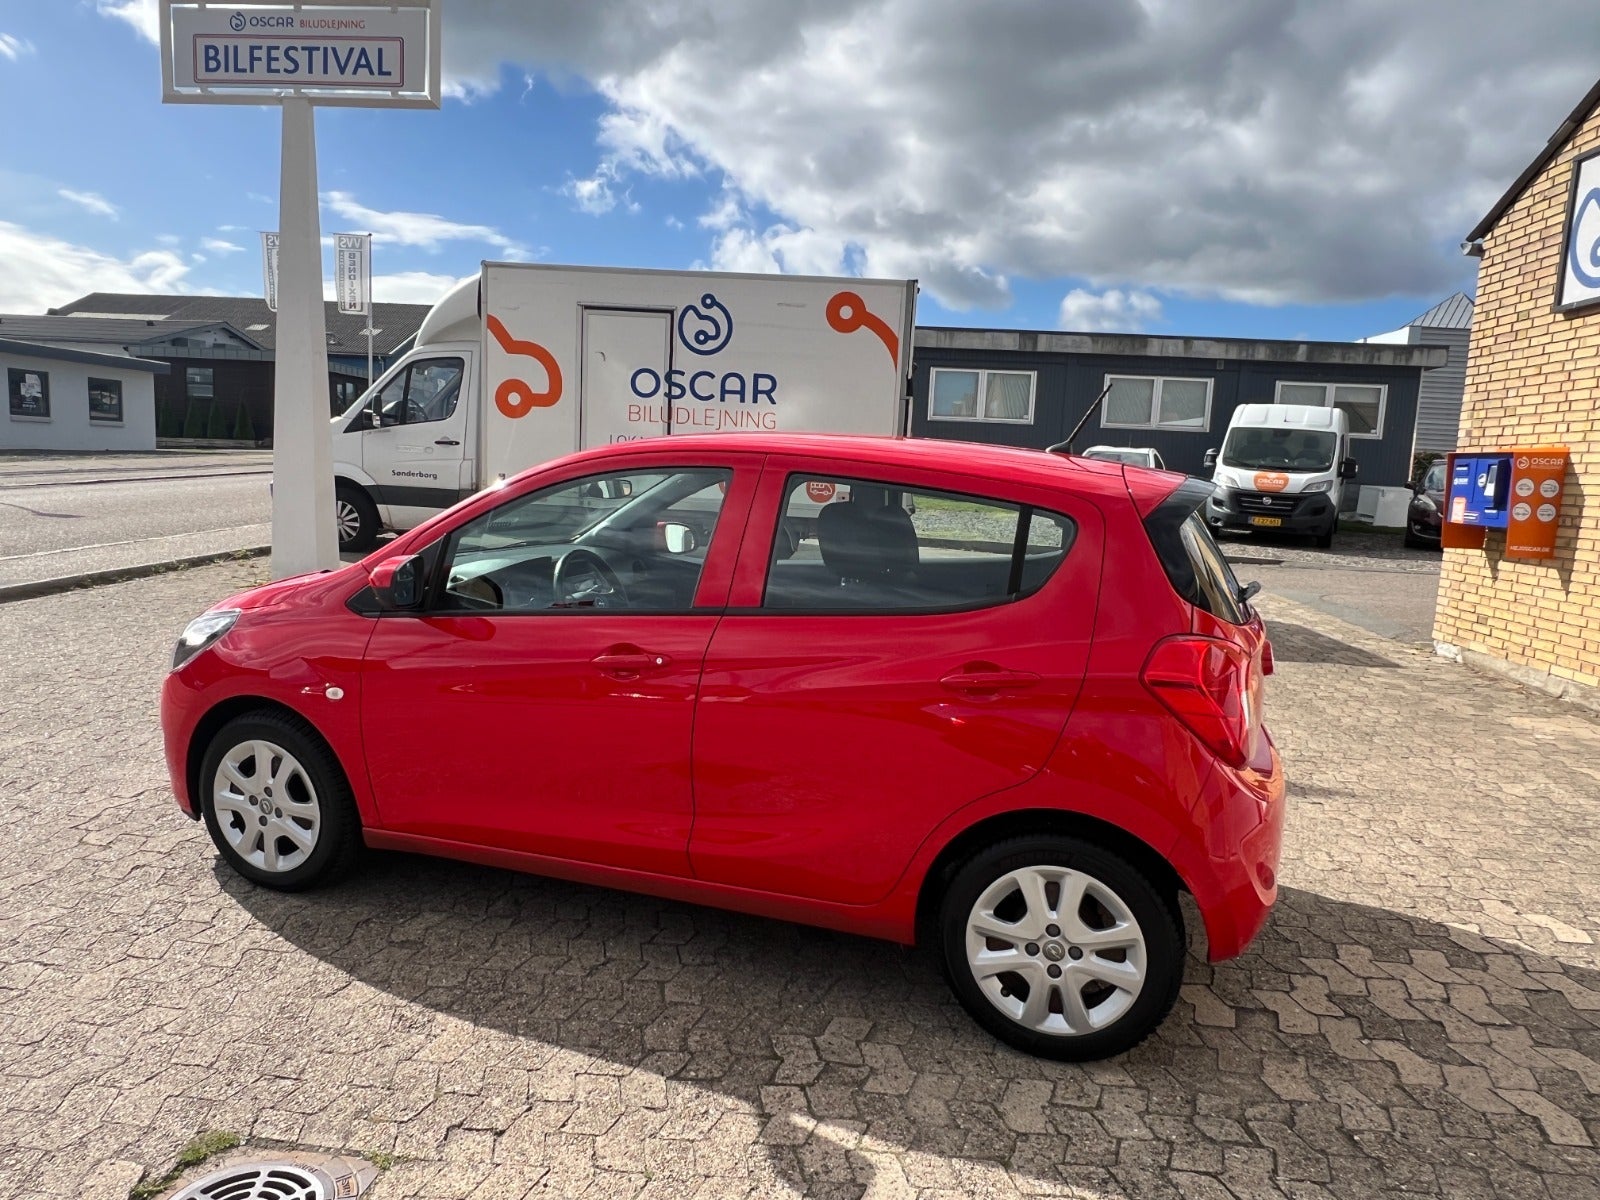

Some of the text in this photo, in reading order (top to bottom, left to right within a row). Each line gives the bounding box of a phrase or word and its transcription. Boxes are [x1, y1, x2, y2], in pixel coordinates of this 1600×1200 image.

[250, 16, 365, 30] OSCAR BILUDLEJNING
[204, 44, 392, 77] BILFESTIVAL
[630, 367, 778, 405] OSCAR
[628, 404, 777, 430] BILUDLEJNING
[1531, 457, 1564, 466] OSCAR
